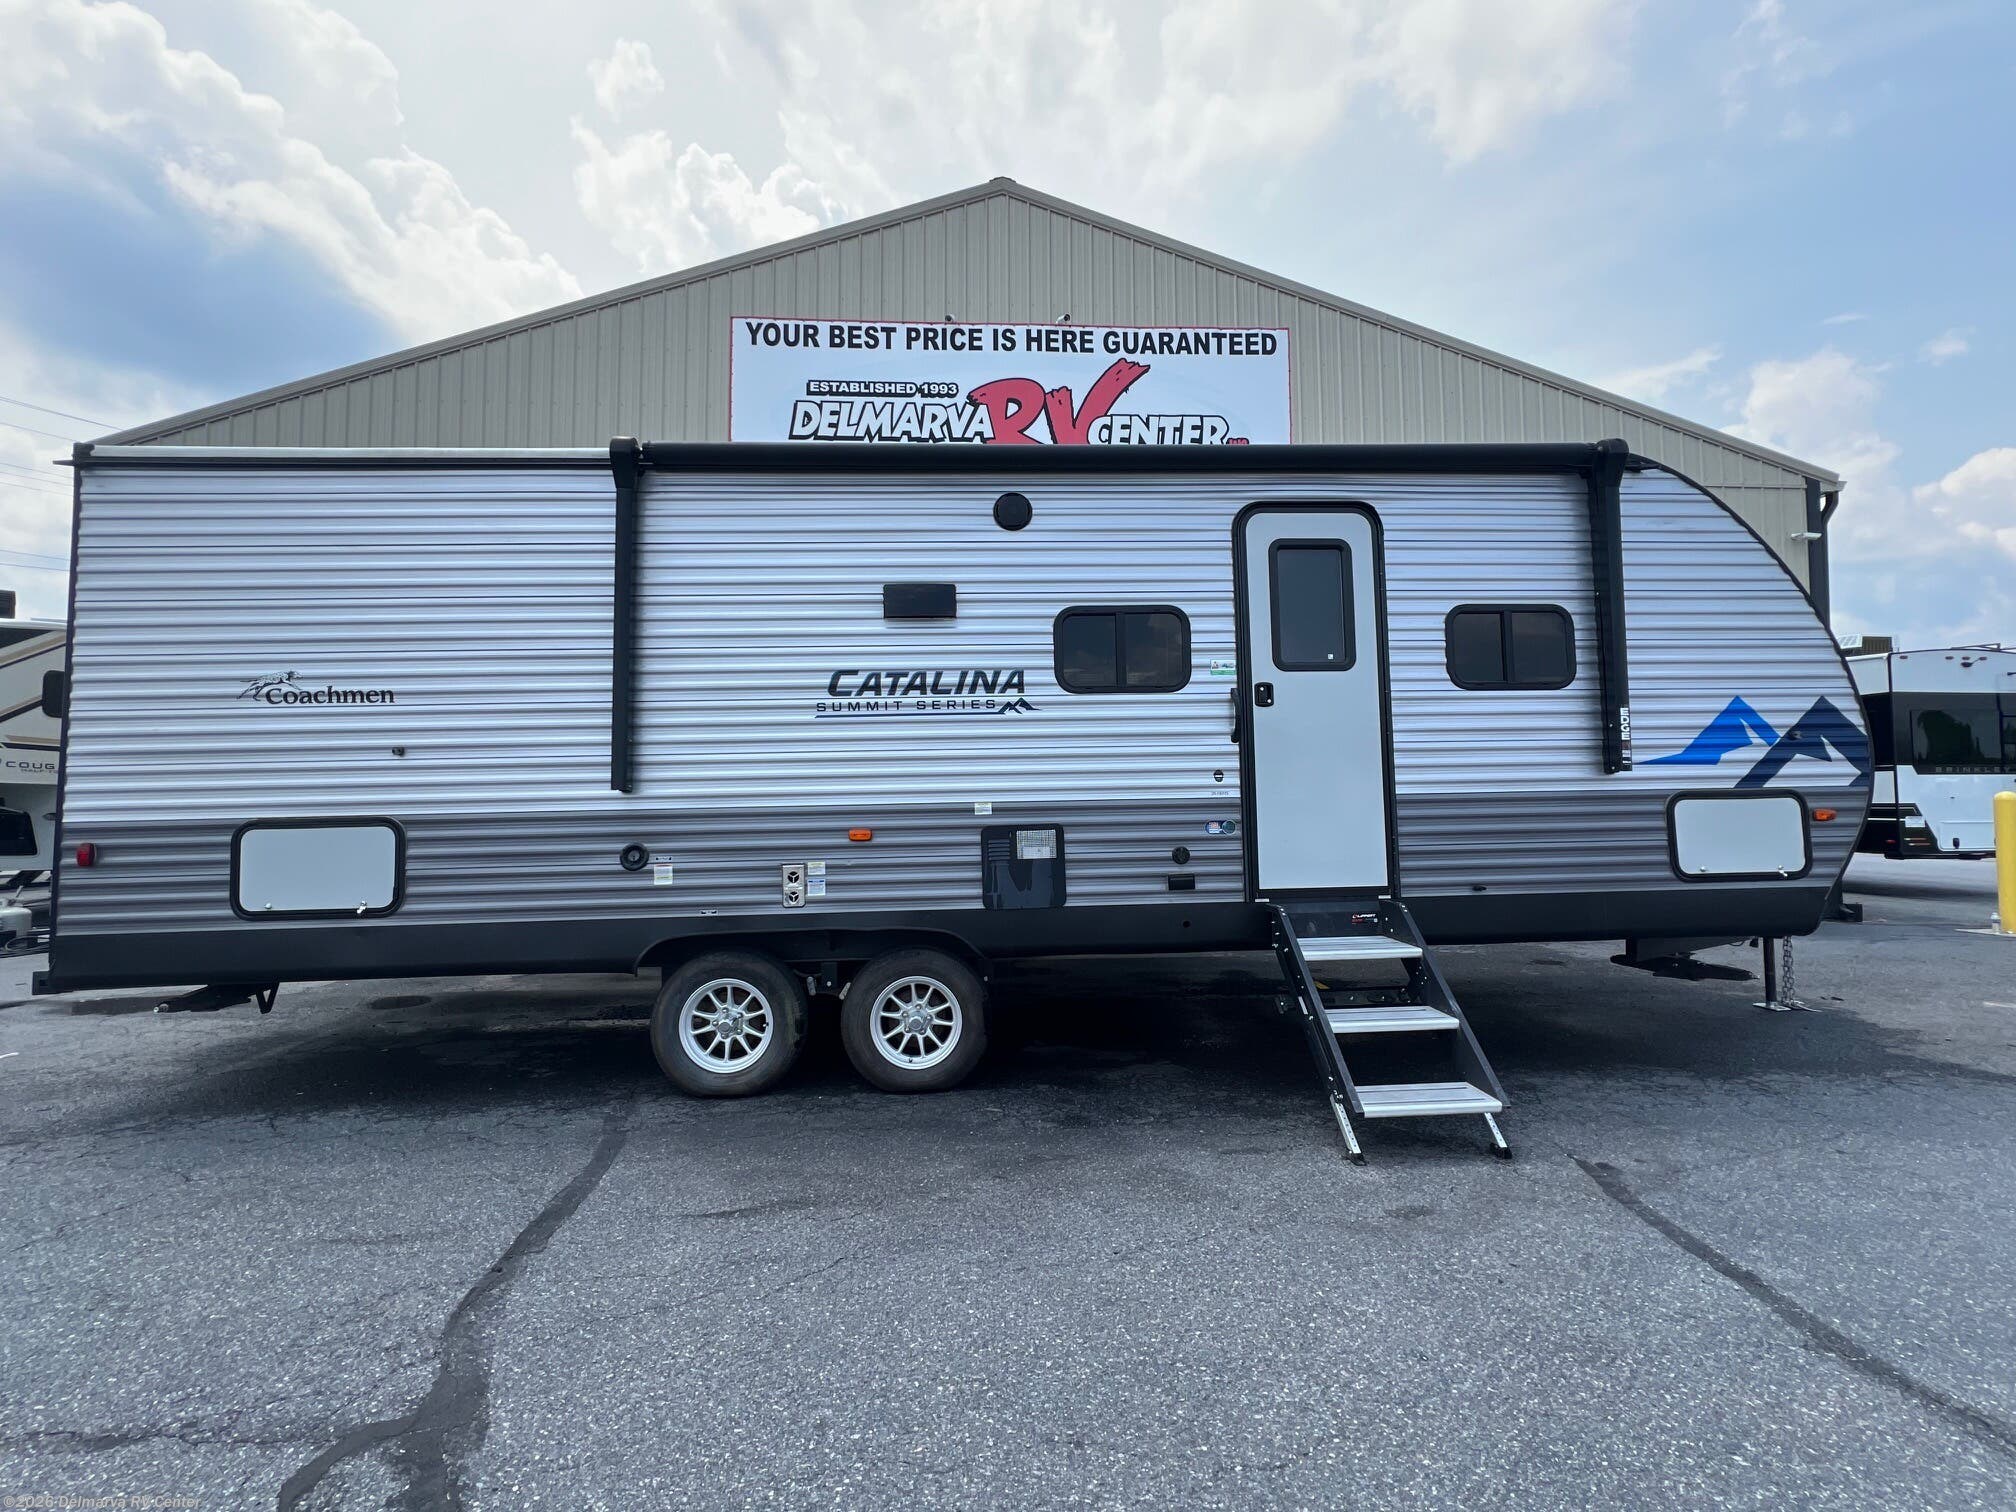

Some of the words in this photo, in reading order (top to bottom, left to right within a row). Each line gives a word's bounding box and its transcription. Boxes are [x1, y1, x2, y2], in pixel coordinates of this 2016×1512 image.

[746, 322, 820, 348] YOUR
[829, 325, 897, 349] BEST
[906, 327, 983, 351] PRICE
[993, 328, 1016, 351] IS
[1025, 329, 1094, 353] HERE
[1103, 331, 1277, 356] GUARANTEED
[789, 400, 996, 443] DELMARVA
[967, 358, 1151, 445] RV
[1087, 414, 1229, 445] CENTER
[807, 380, 917, 396] ESTABLISHED
[920, 383, 959, 397] 1993
[265, 686, 395, 705] Coachmen
[827, 669, 1025, 697] CATALINA
[816, 701, 900, 712] SUMMIT
[916, 700, 996, 710] SERIES
[1620, 708, 1631, 741] EDGE
